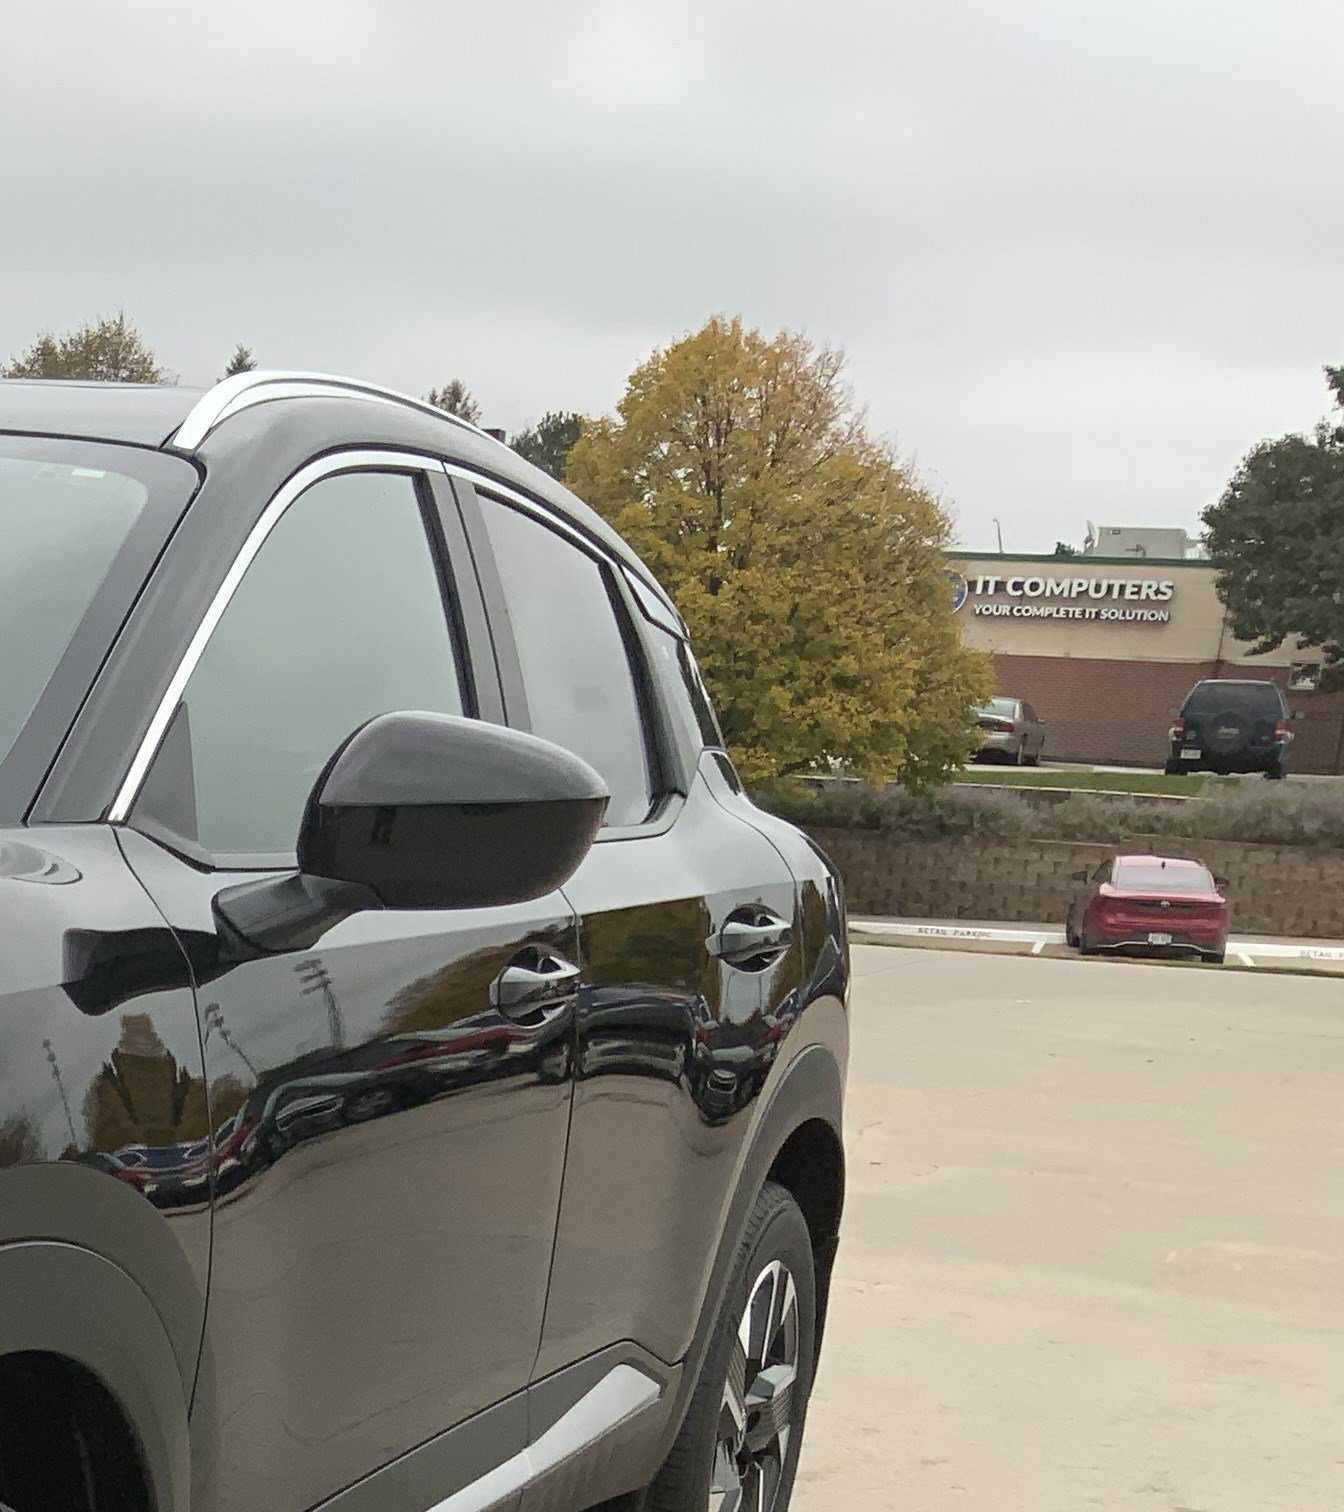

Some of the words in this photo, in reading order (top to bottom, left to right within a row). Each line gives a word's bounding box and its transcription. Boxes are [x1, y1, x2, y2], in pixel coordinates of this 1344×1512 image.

[975, 575, 1001, 595] IT
[1006, 576, 1174, 600] COMPUTERS
[973, 604, 1011, 616] YOUR
[1013, 605, 1083, 619] COMPLETE
[1084, 608, 1098, 619] IT
[1100, 608, 1170, 622] SOLUTION
